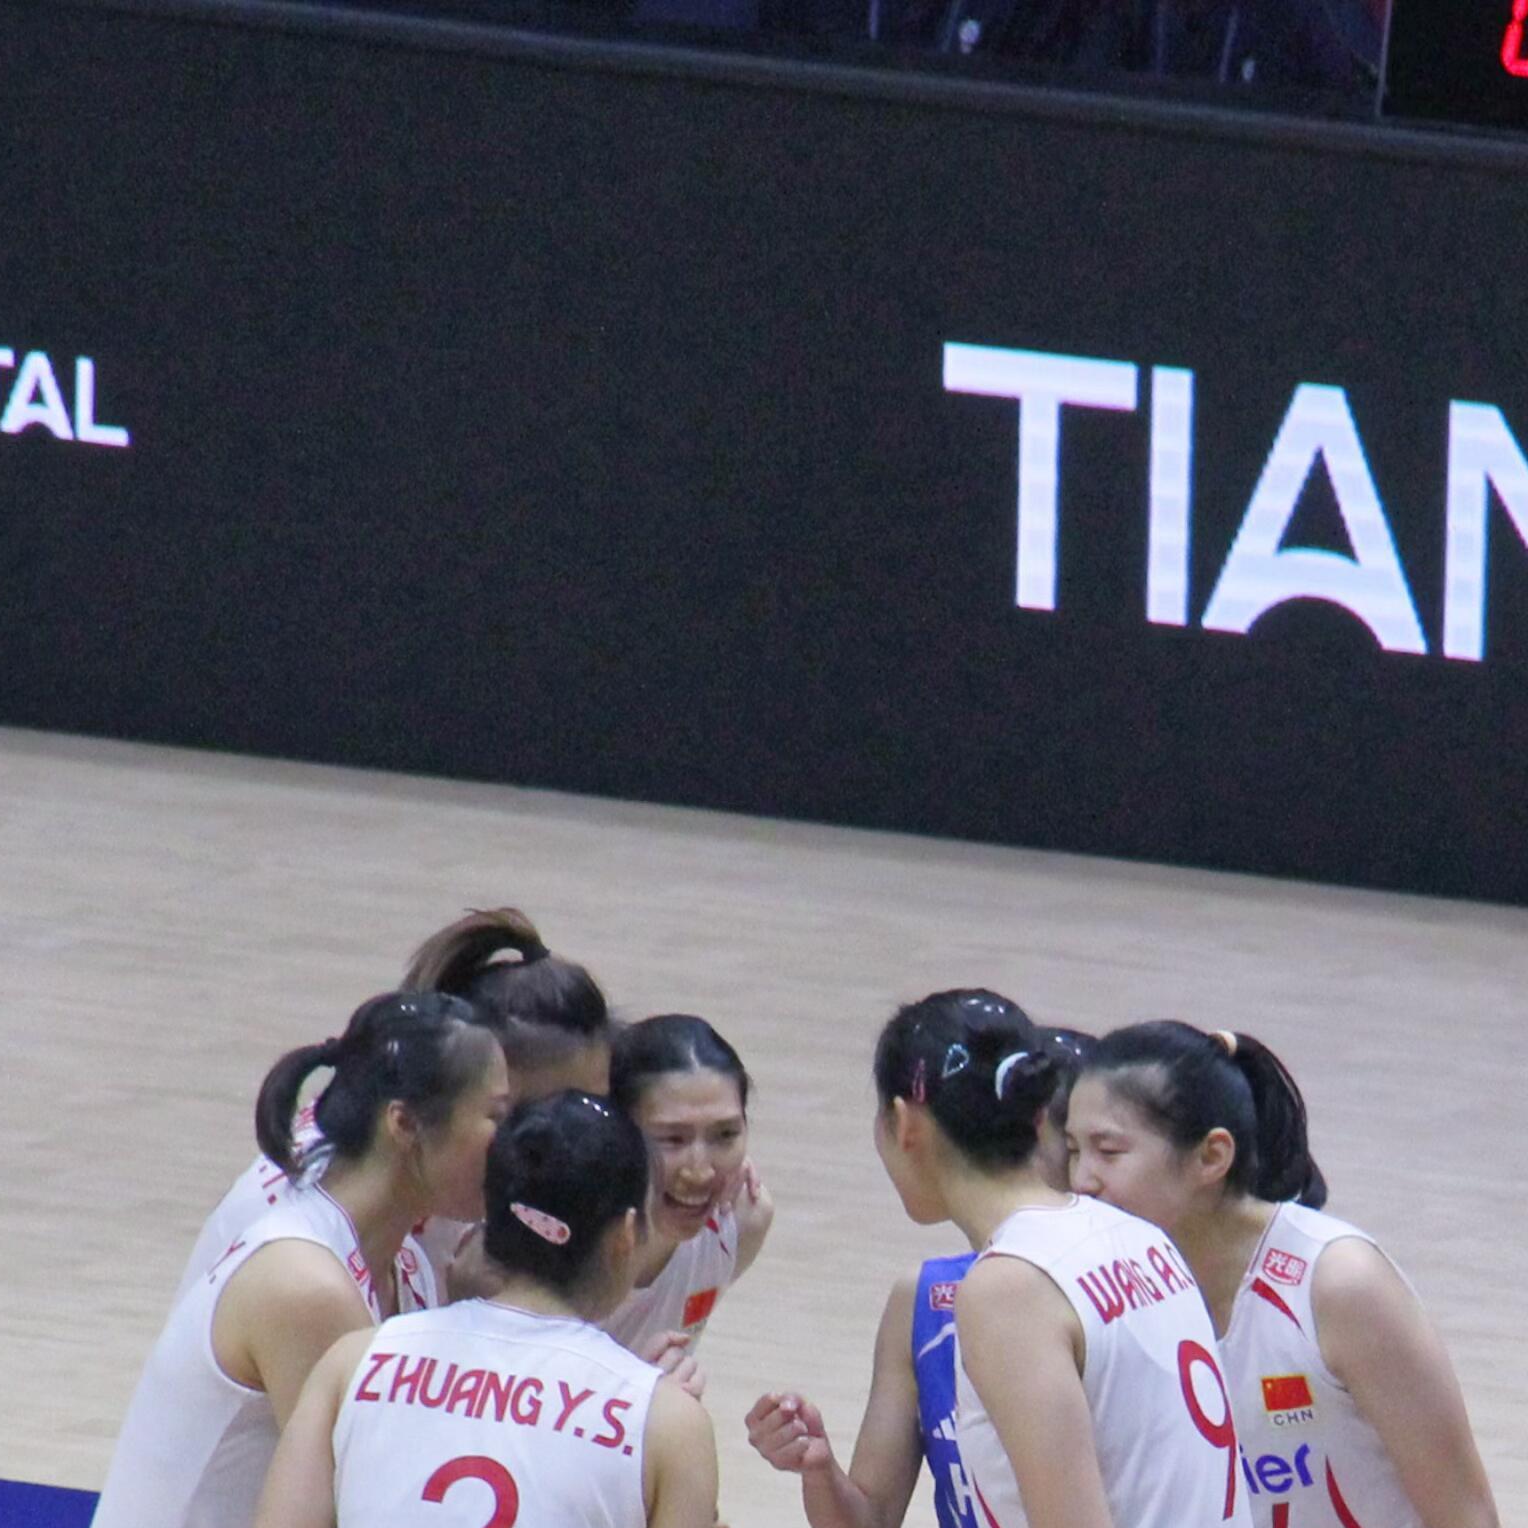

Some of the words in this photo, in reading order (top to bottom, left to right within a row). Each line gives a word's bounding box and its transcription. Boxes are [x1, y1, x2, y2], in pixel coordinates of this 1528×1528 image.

[1075, 1257, 1165, 1325] WANG
[354, 1353, 545, 1427] ZHUANG
[552, 1379, 634, 1457] Y.S.
[1176, 1339, 1237, 1521] 9
[1272, 1408, 1314, 1427] CHN
[1237, 1443, 1315, 1495] ier
